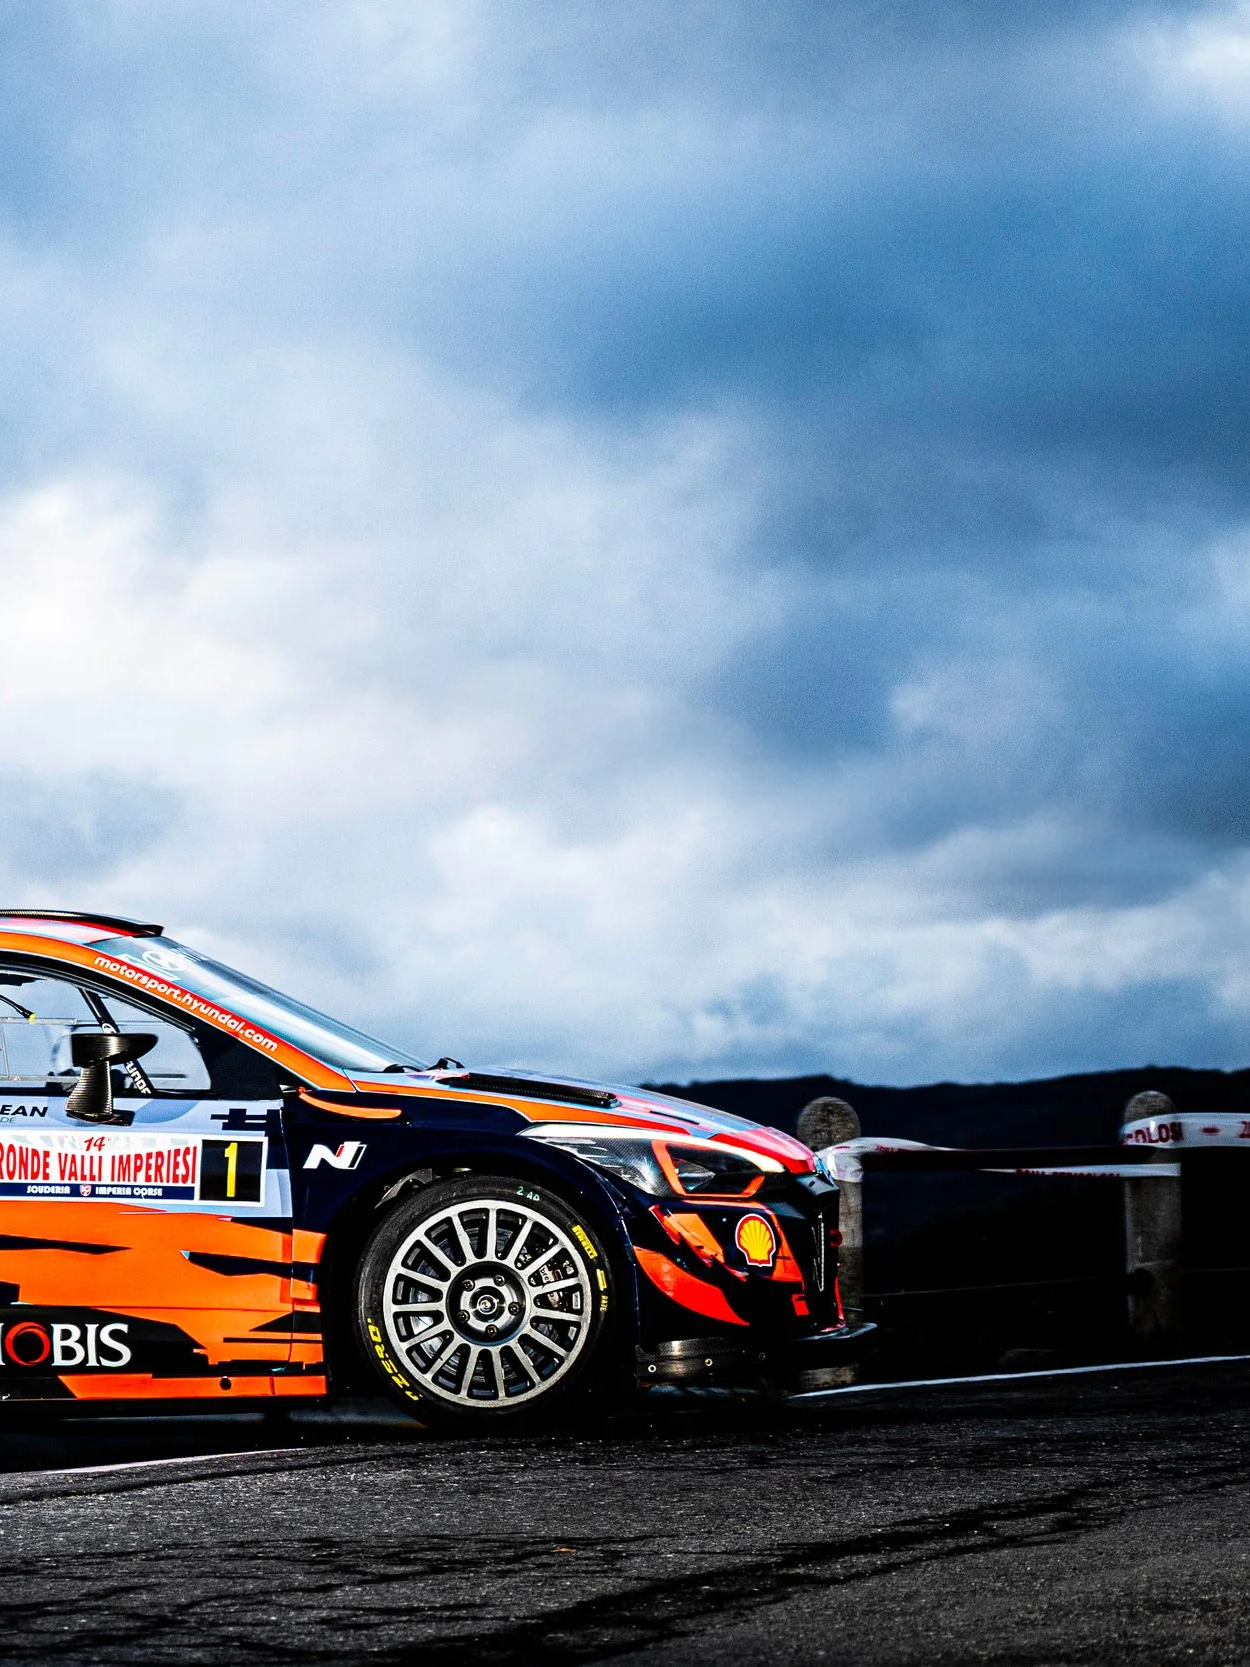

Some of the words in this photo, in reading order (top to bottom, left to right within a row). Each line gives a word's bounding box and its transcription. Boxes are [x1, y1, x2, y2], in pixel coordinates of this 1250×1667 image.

[94, 956, 278, 1053] motorsport.hyundai.com
[58, 1152, 103, 1182] VALLI
[111, 1146, 197, 1184] IMPERIESI
[224, 1142, 238, 1198] 1
[26, 1184, 71, 1195] SCUDERIA
[95, 1186, 132, 1196] IMPERIA
